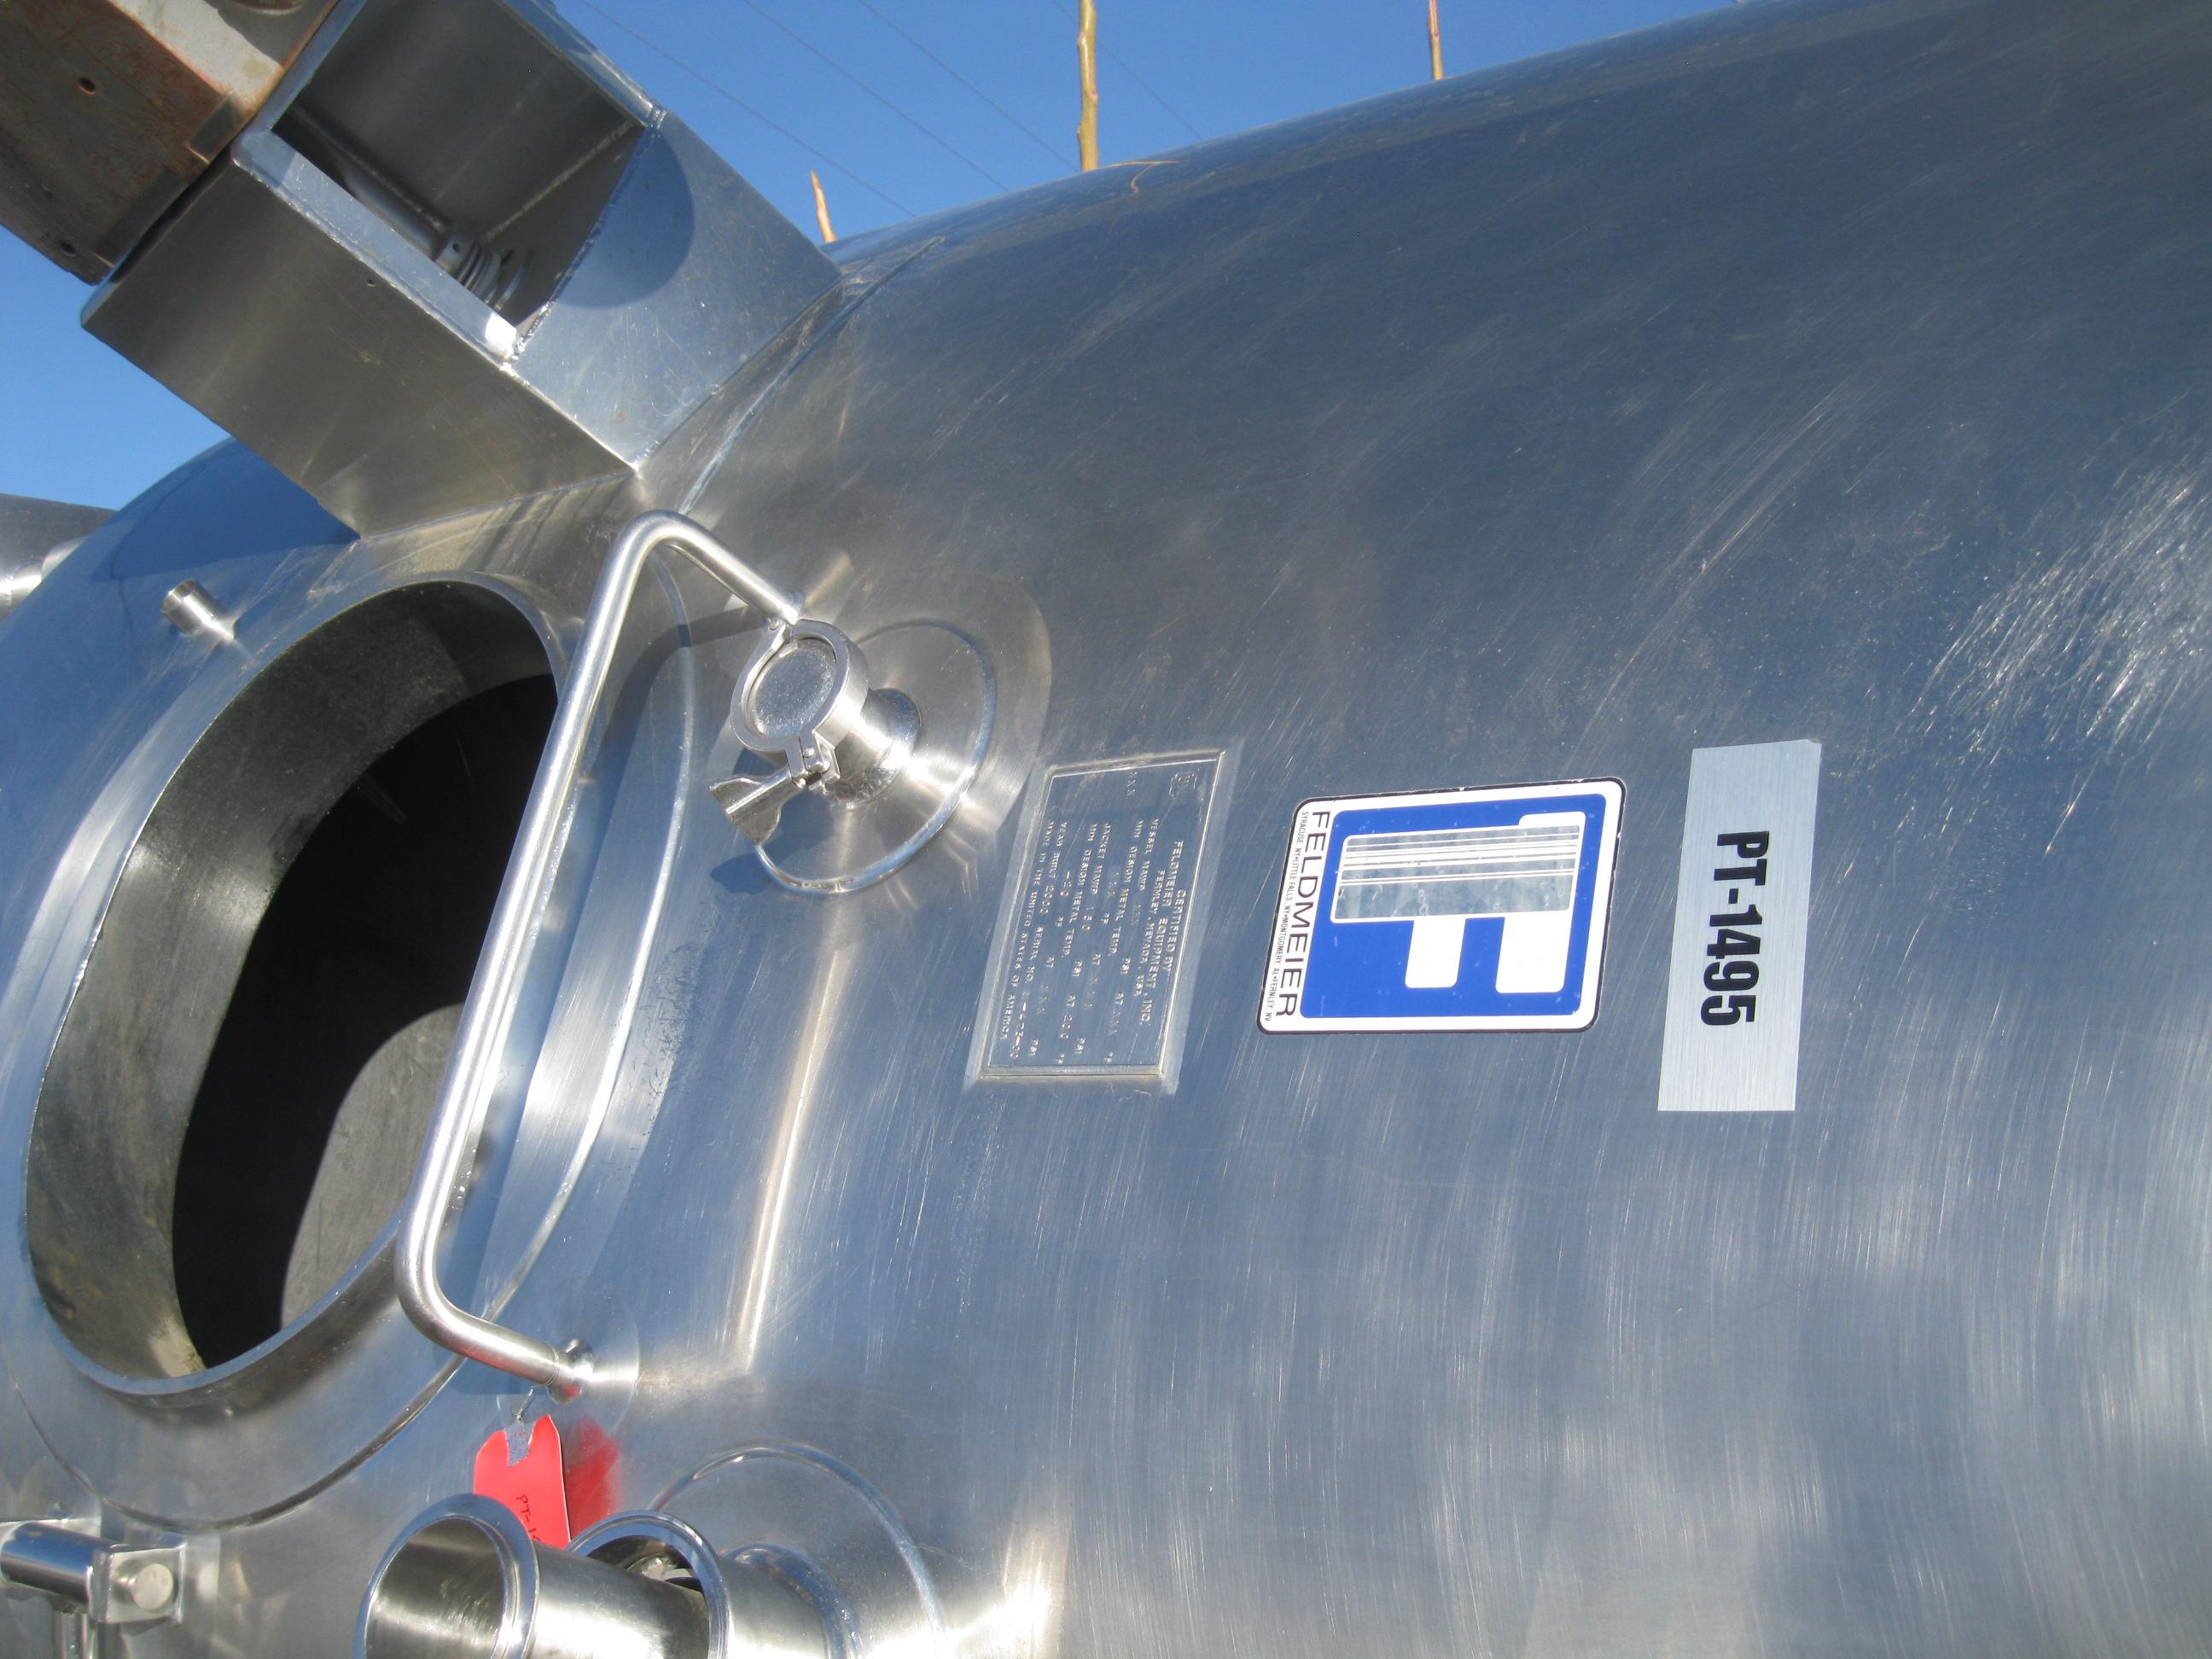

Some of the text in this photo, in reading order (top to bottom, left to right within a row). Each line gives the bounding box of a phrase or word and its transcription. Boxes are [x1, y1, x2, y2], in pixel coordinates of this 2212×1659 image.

[1057, 821, 1068, 847] YEAR
[1087, 823, 1097, 841] MIN
[1097, 823, 1111, 859] JACKET
[1144, 818, 1160, 853] VESSEL
[1049, 853, 1060, 879] BUILT
[1077, 849, 1091, 886] DESIGN
[1091, 864, 1103, 894] MAWP
[1138, 860, 1150, 890] MAWP
[1162, 841, 1184, 906] FELDMEIER
[1108, 819, 1144, 956] MIN DESIGN METAL TEMP.
[1068, 891, 1083, 923] METAL
[1276, 812, 1330, 1016] FELDMEIER
[1000, 820, 1055, 1039] MADE IN THE UNITED STATES OF AMERICA
[1162, 889, 1186, 971] CERTIFIED BY
[1701, 830, 1769, 1026] PT-1495
[1029, 927, 1044, 960] SERIAL
[1046, 956, 1055, 968] AT
[1072, 959, 1083, 976] PSI
[1092, 953, 1101, 966] AT
[1120, 957, 1132, 975] PSI
[1115, 991, 1124, 1005] AT
[1133, 975, 1144, 996] USA
[1067, 993, 1076, 1007] AT
[1140, 999, 1152, 1024] INC.
[1028, 1039, 1039, 1056] PSI
[1074, 1038, 1086, 1054] PSI
